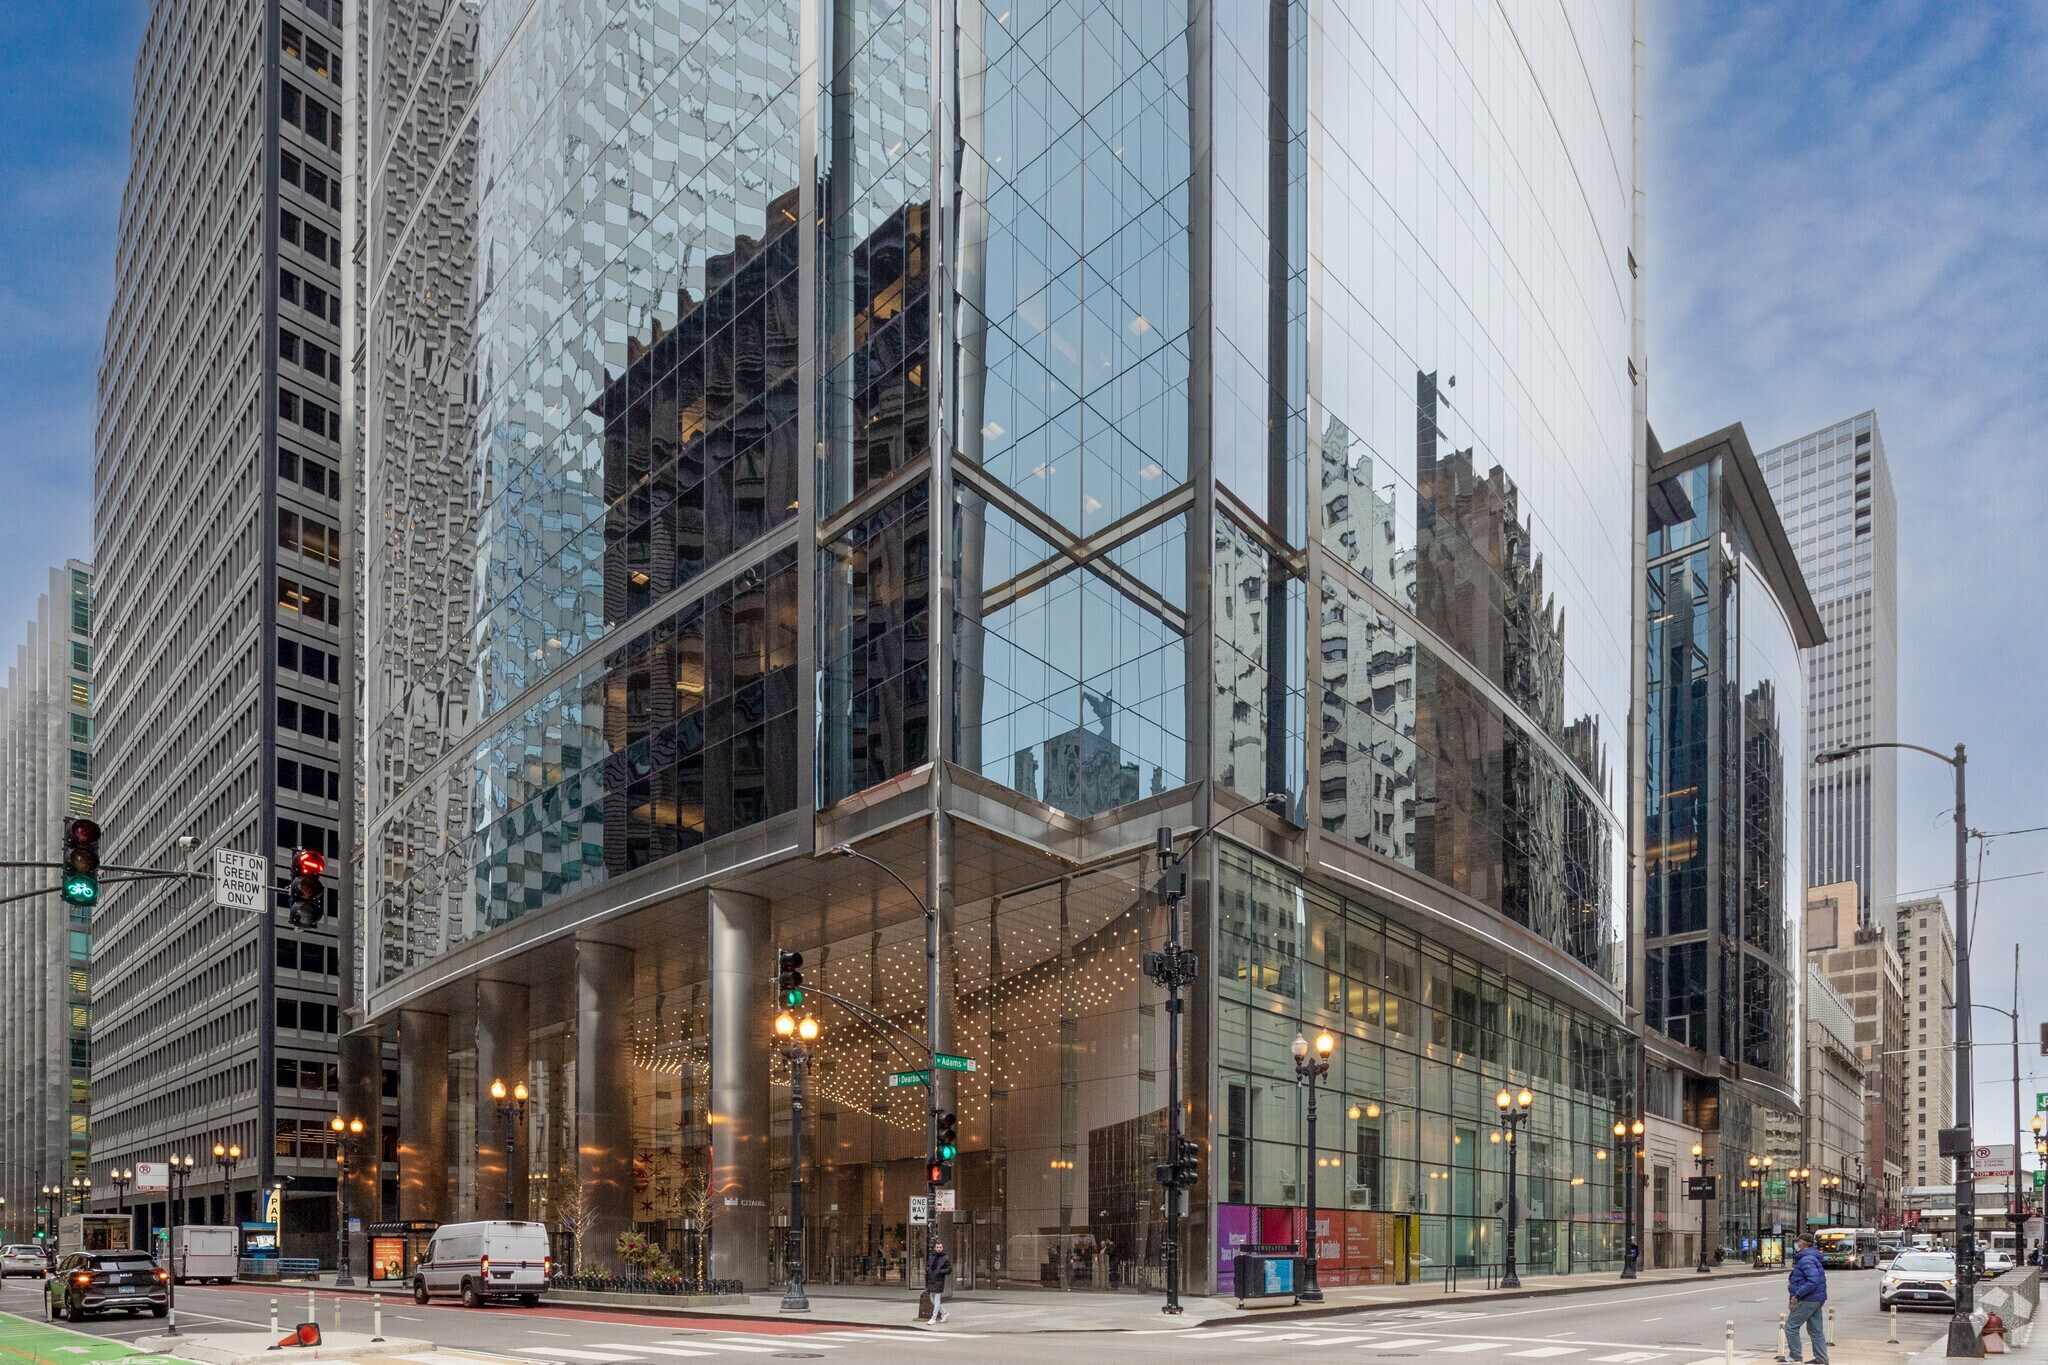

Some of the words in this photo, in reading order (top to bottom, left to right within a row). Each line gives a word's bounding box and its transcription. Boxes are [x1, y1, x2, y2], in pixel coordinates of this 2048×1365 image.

[219, 852, 245, 867] LEFT
[249, 858, 263, 871] ON
[224, 866, 258, 882] GREEN
[222, 879, 260, 894] ARROW
[227, 891, 254, 906] ONLY
[942, 1058, 962, 1068] Adams
[912, 1198, 926, 1206] ONE
[912, 1206, 926, 1214] WAY
